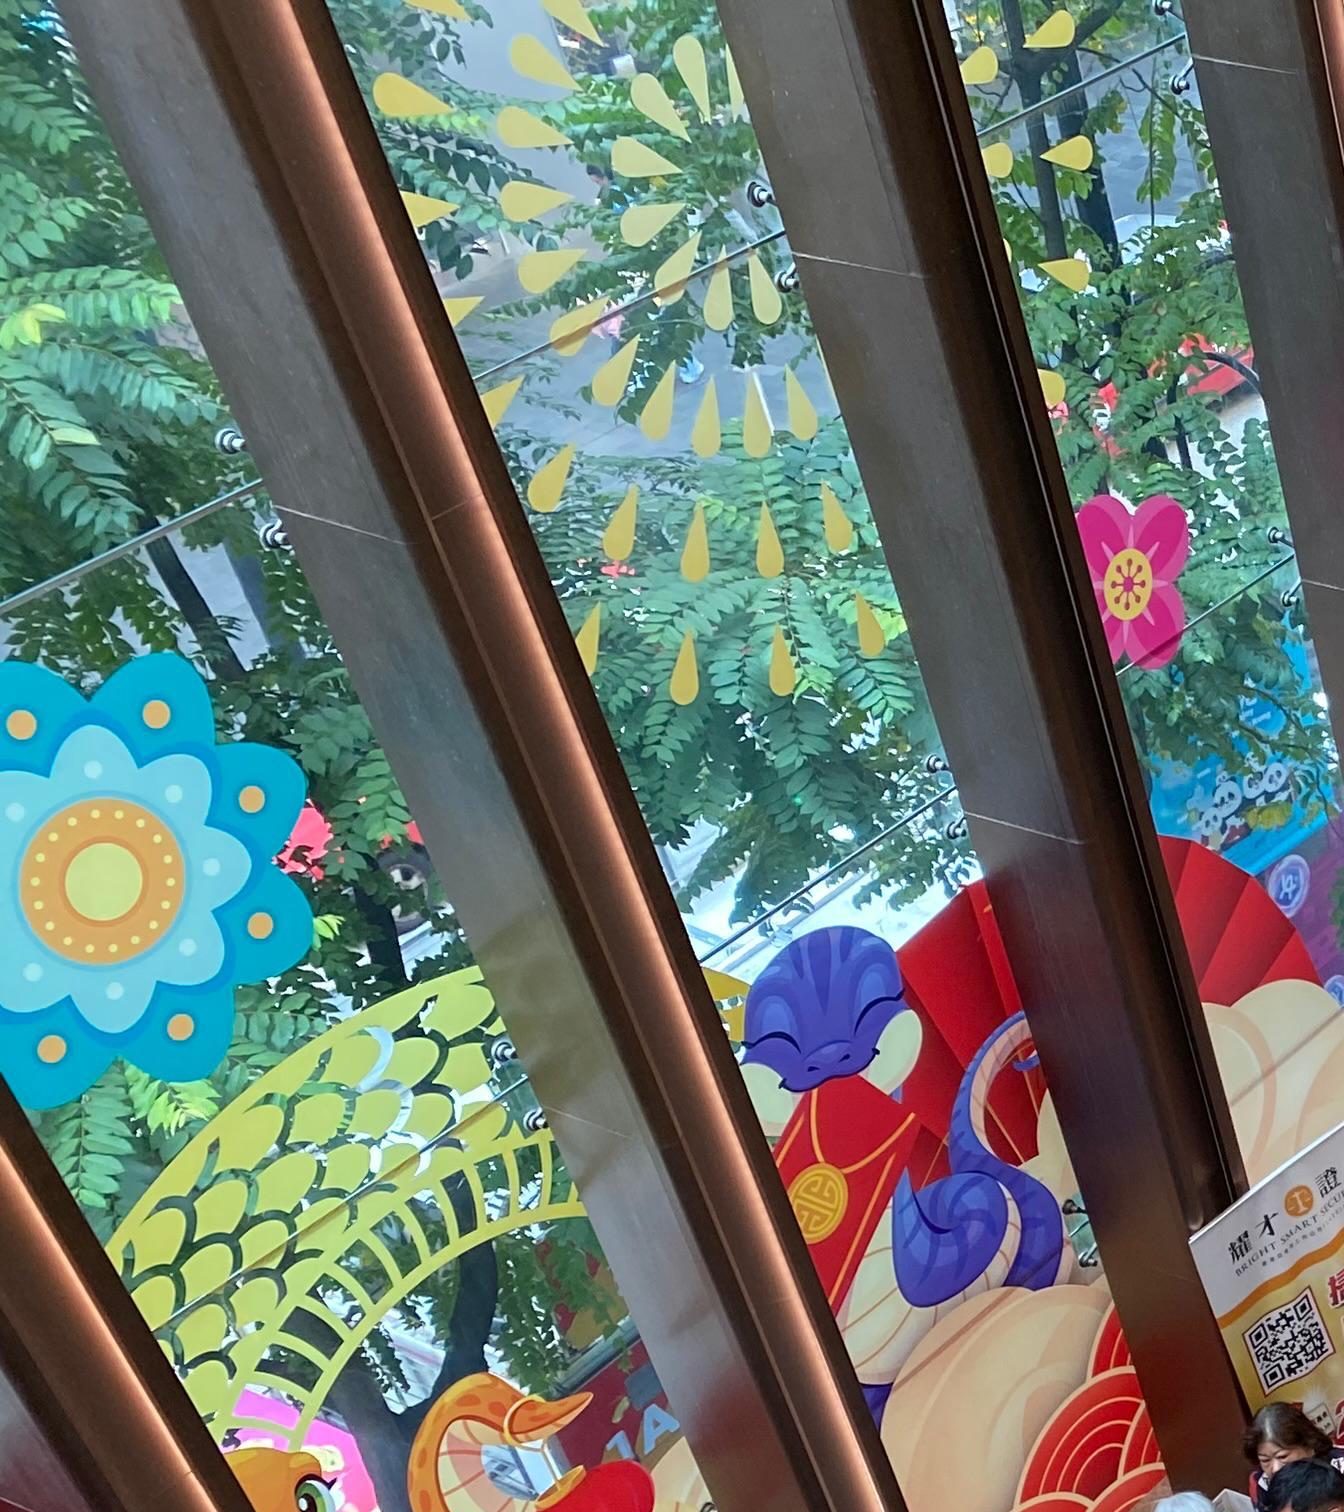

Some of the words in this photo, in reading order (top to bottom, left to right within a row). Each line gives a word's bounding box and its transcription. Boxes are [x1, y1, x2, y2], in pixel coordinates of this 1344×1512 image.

[1228, 1212, 1279, 1264] 耀才
[1235, 1240, 1277, 1277] BRIGHT
[1280, 1213, 1319, 1244] SMART
